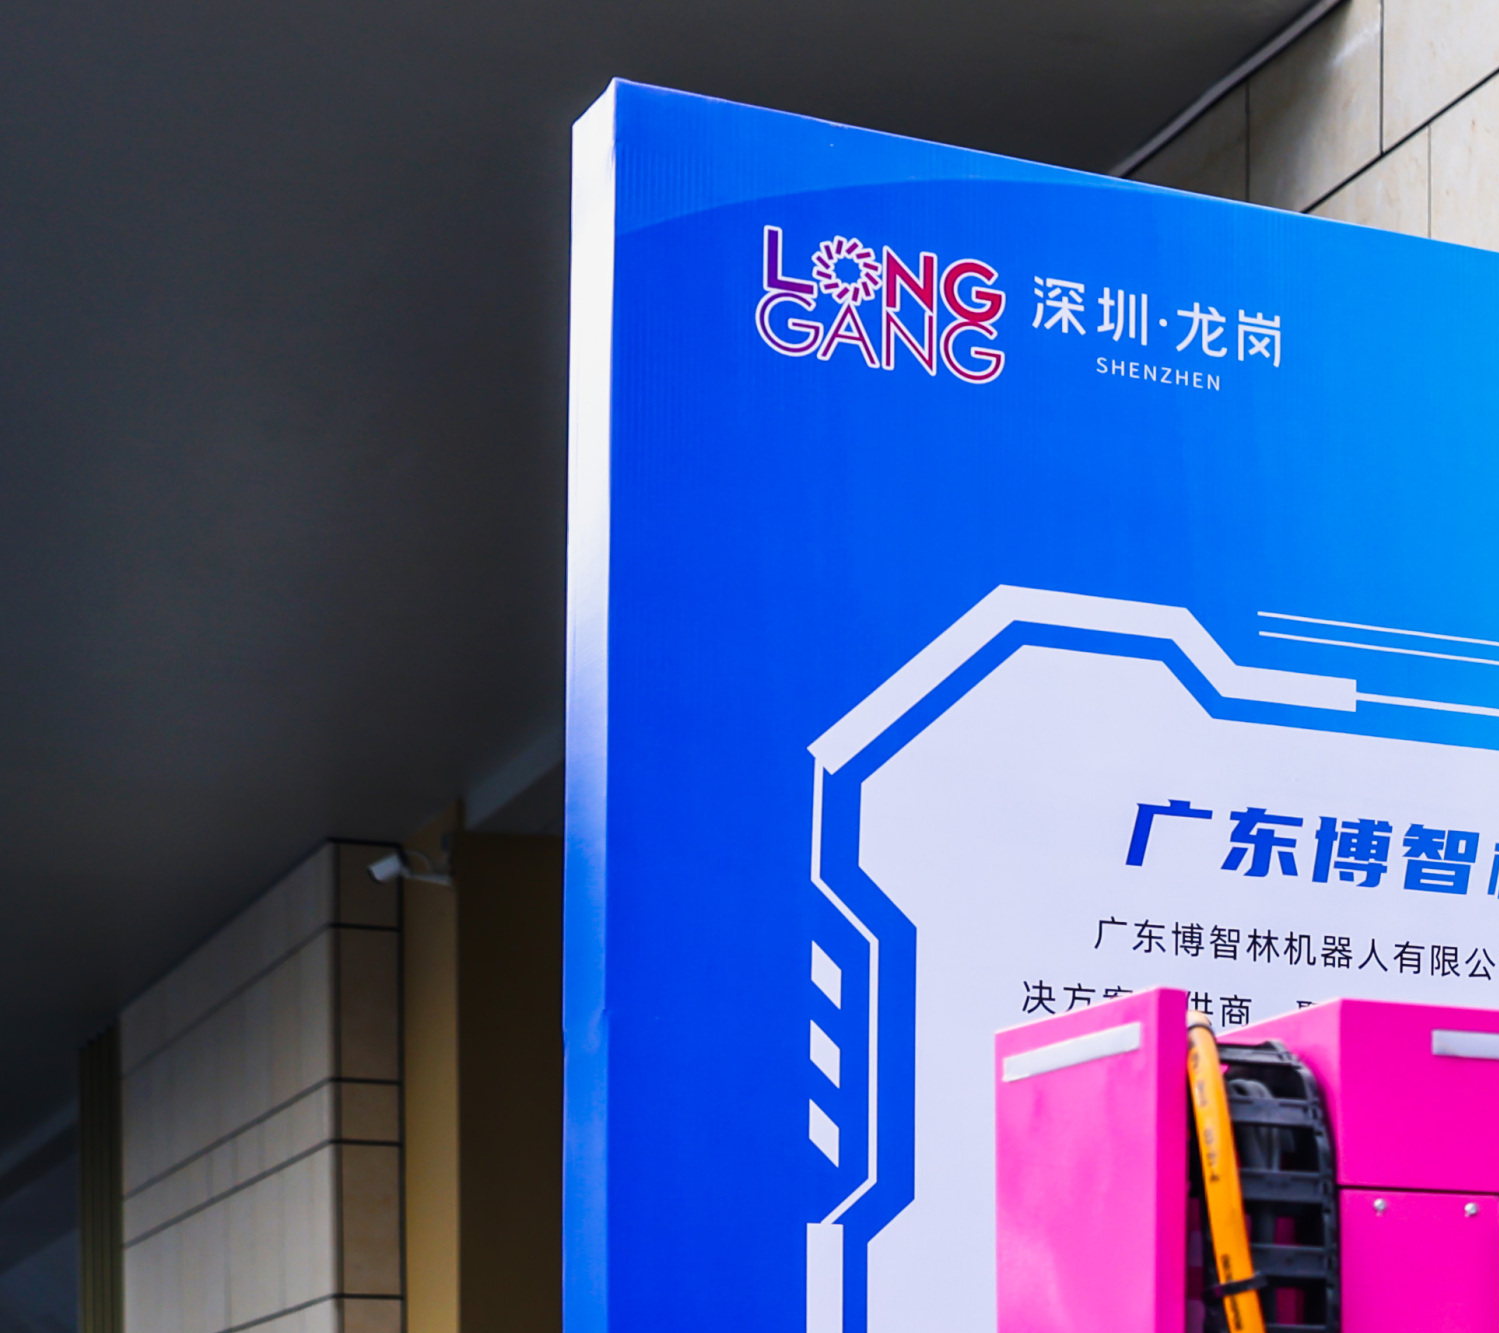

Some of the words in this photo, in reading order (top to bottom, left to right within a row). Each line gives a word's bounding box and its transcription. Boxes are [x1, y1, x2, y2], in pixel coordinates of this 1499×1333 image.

[763, 225, 1005, 325] LONG
[1031, 275, 1283, 368] 深圳·龙岗
[755, 291, 1005, 384] GANG
[1096, 356, 1222, 391] SHENZHEN
